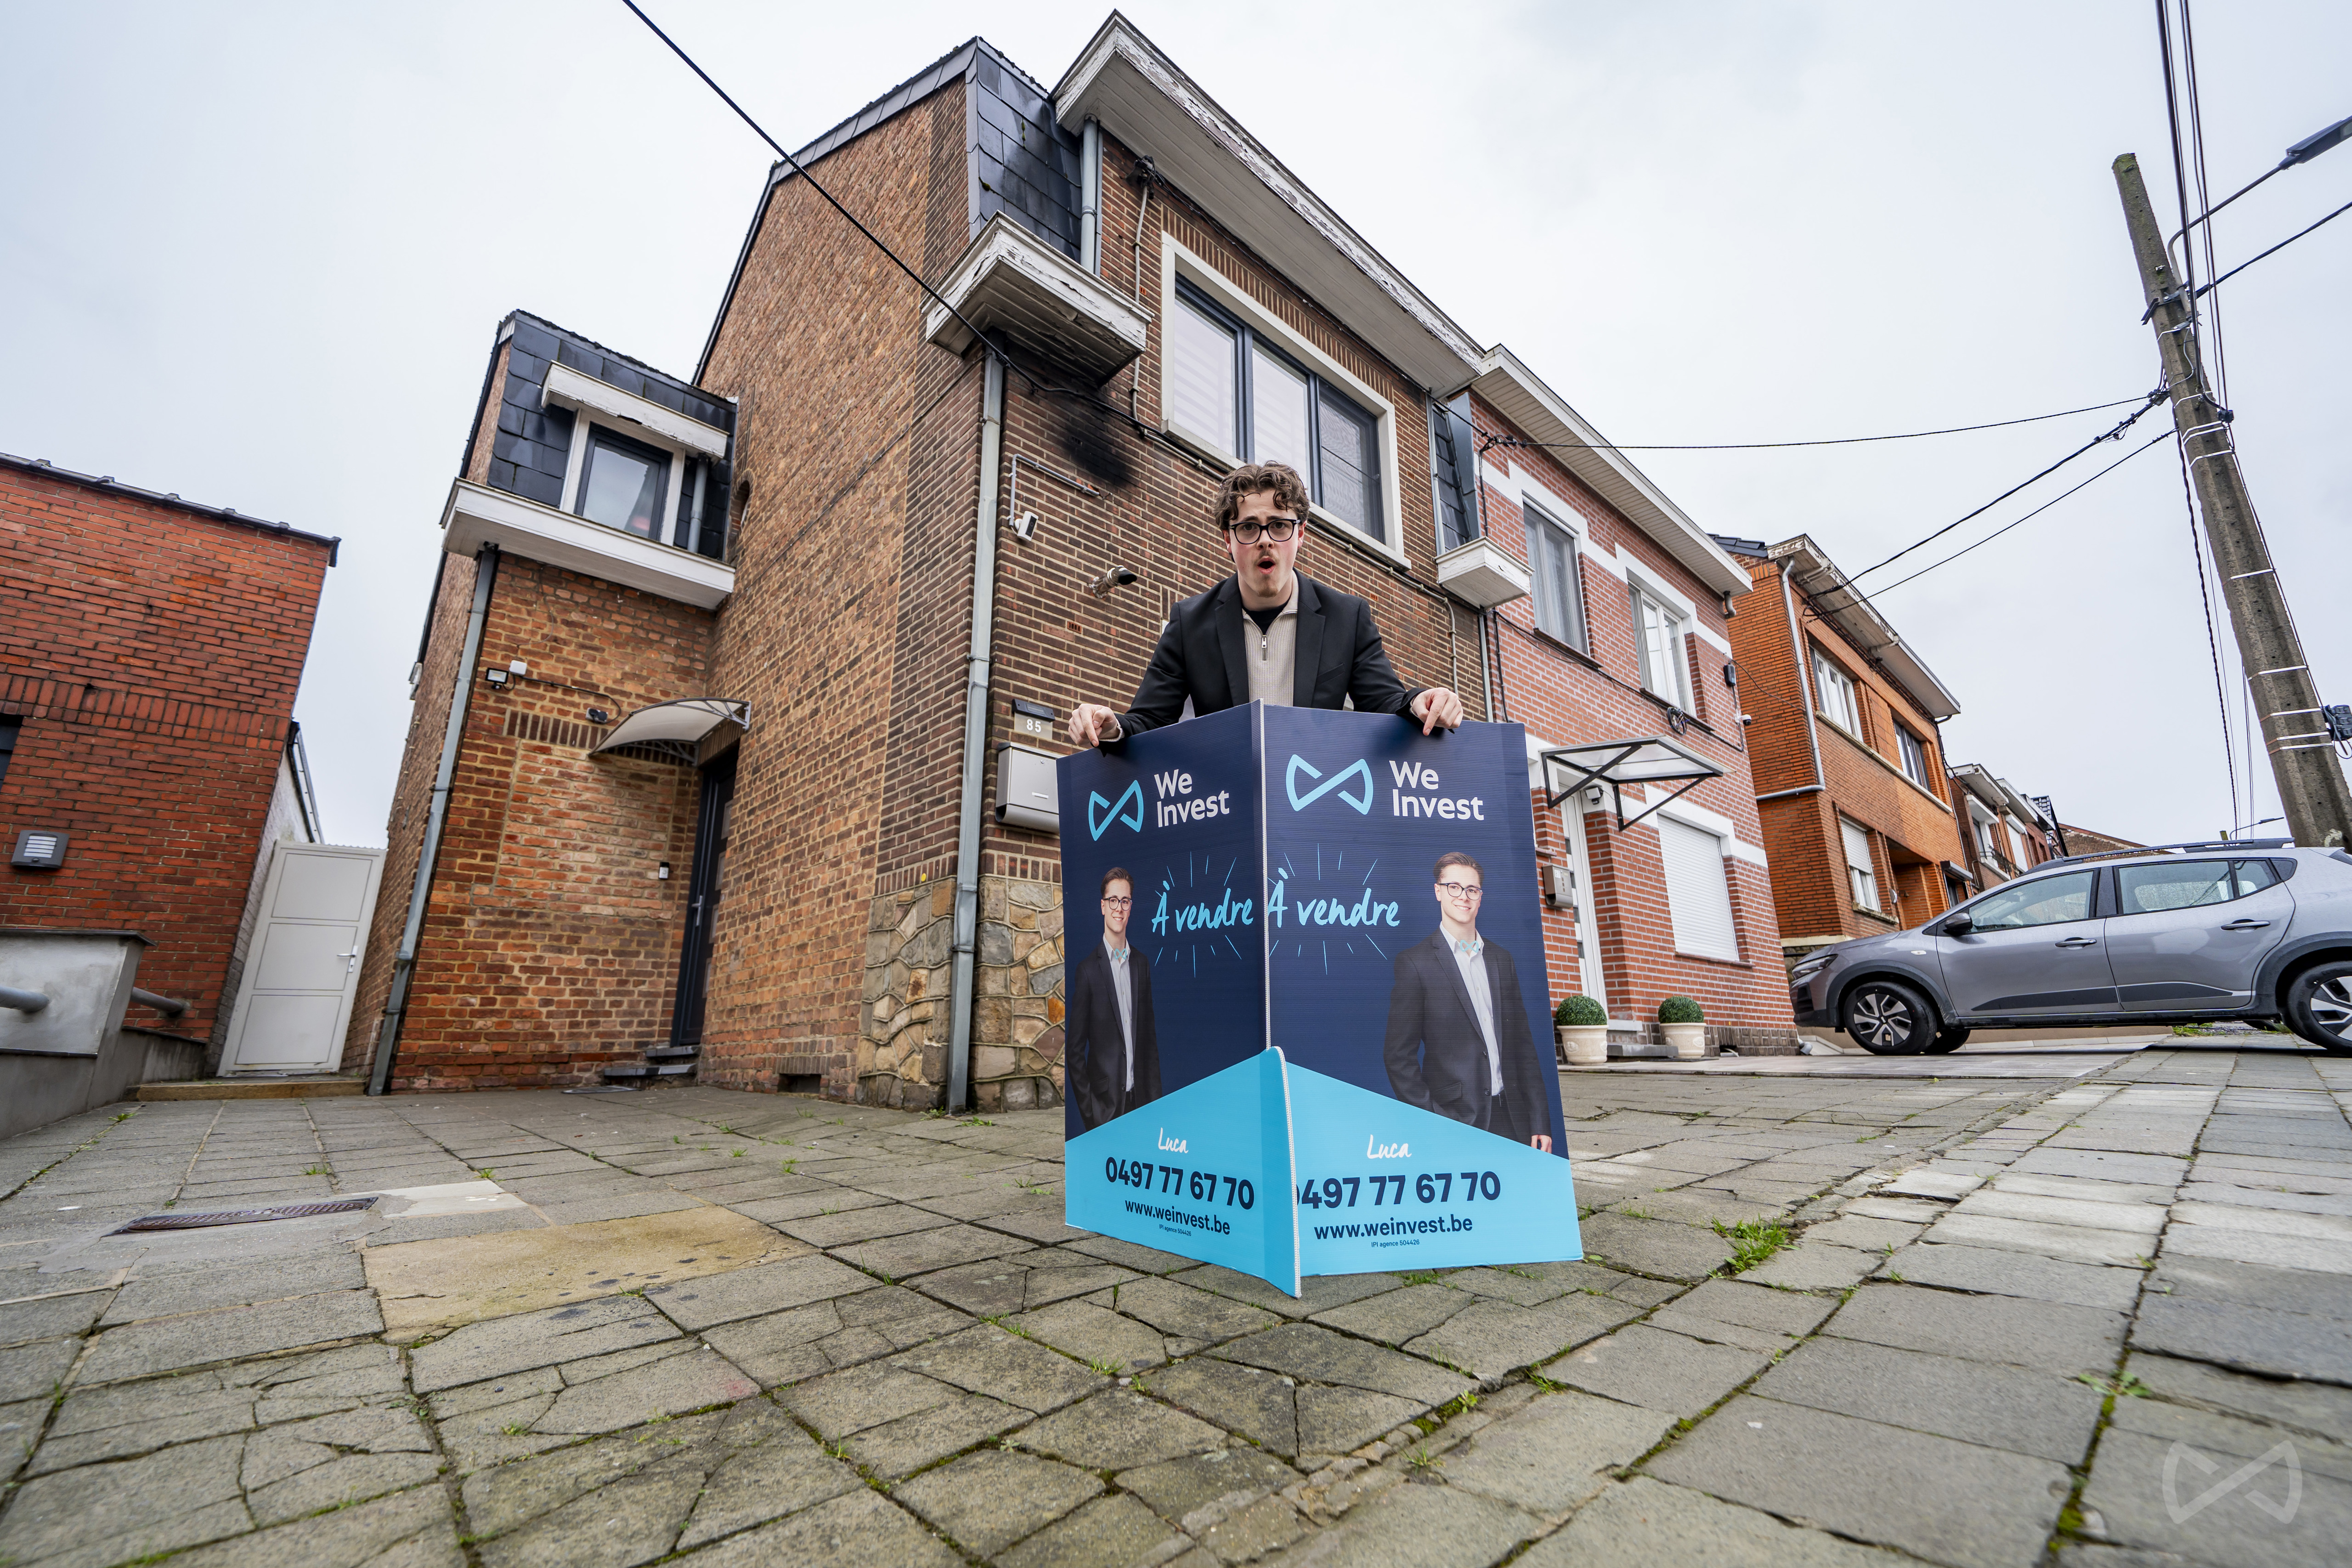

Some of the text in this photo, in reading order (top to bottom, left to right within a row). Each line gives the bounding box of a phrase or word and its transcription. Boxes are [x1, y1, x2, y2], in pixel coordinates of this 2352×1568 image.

[1026, 719, 1041, 733] 85
[1154, 769, 1192, 799] We
[1389, 760, 1439, 790] We
[1157, 790, 1229, 827] Invest
[1392, 789, 1484, 821] Invest
[1152, 880, 1254, 936] À vendre
[1267, 867, 1401, 928] À vendre
[1158, 1127, 1189, 1154] Luca
[1367, 1134, 1412, 1159] Luca
[1105, 1156, 1255, 1210] 0497 77 67 70
[1369, 1175, 1406, 1206] 77
[1416, 1173, 1452, 1203] 67
[1460, 1171, 1501, 1201] 70
[1125, 1200, 1230, 1235] www.weinvest.be
[1177, 1228, 1192, 1236] 504426
[1314, 1214, 1472, 1240] www.weinvest.be
